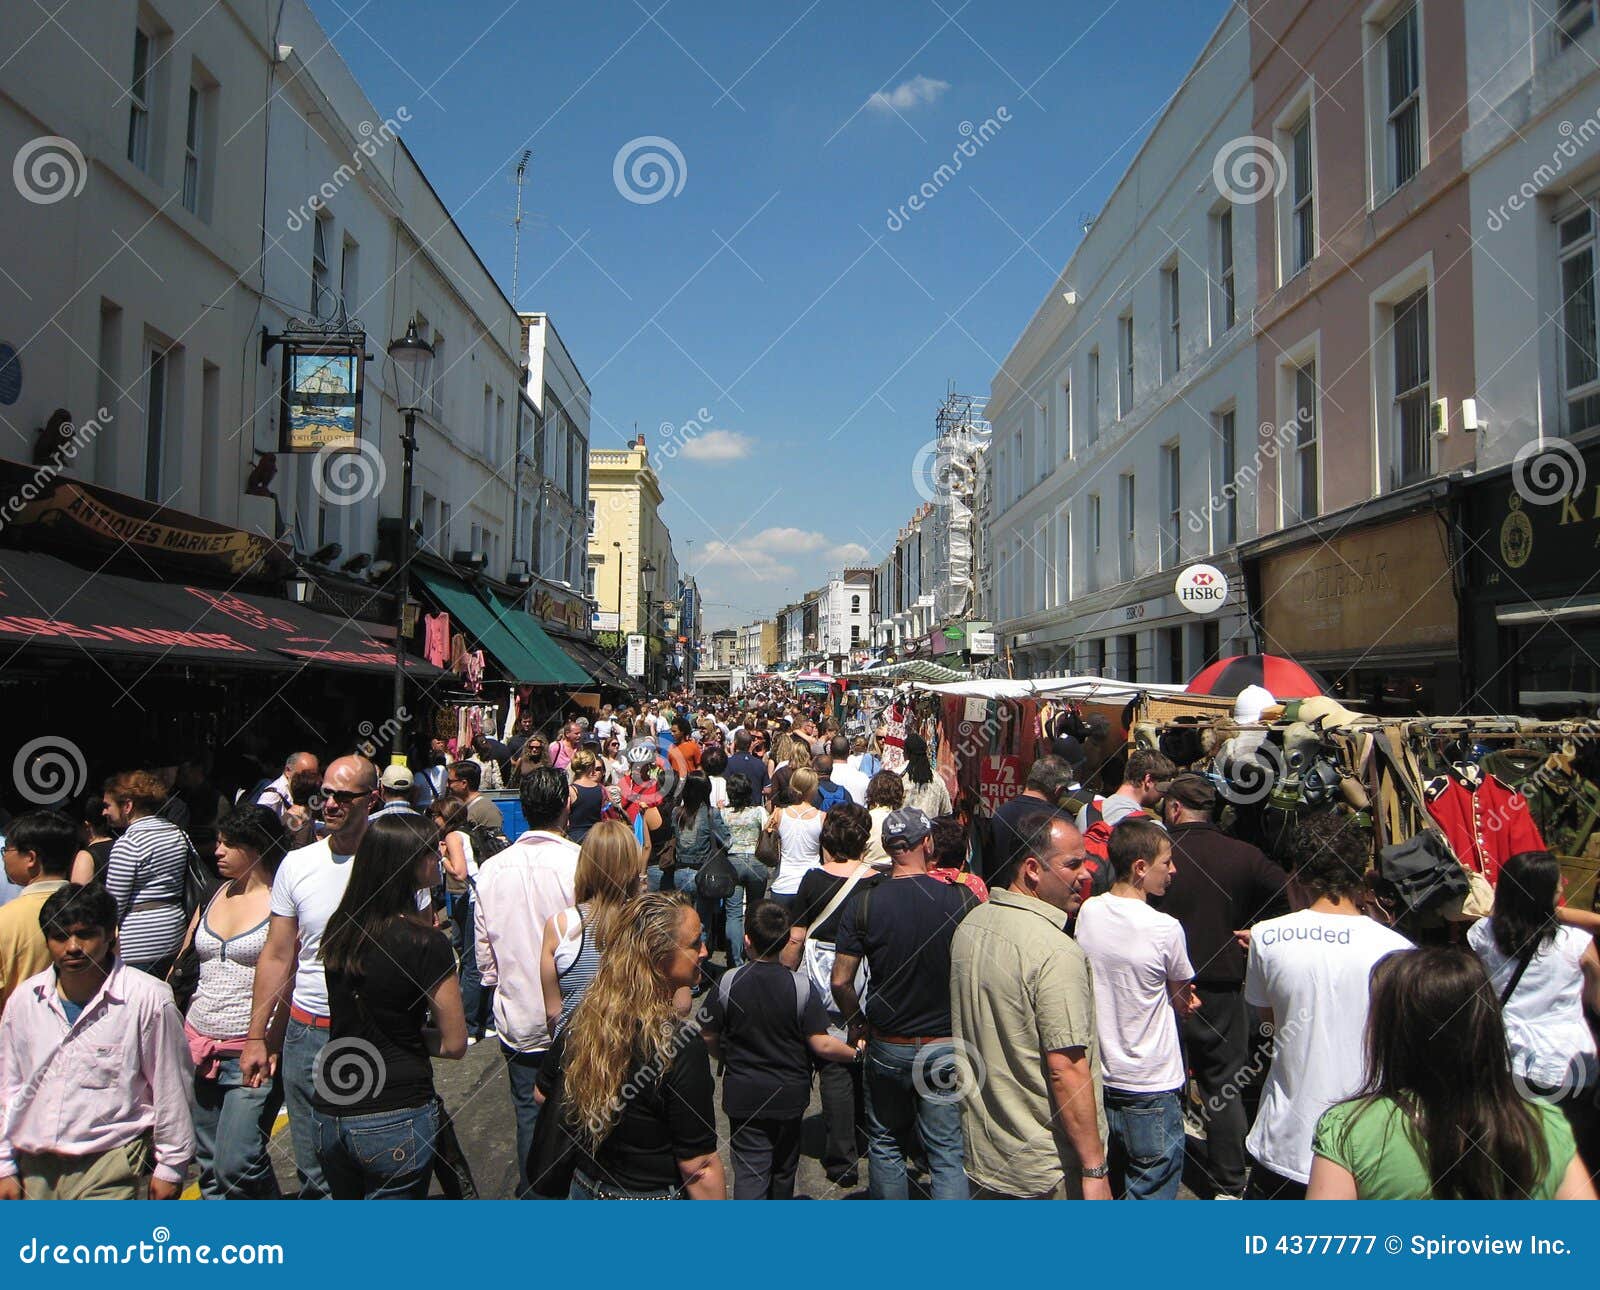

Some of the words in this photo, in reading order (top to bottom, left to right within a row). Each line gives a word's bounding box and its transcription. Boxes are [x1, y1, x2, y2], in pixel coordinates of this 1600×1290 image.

[68, 496, 161, 544] ANTIQUES
[163, 530, 233, 551] MARKET
[1183, 587, 1224, 600] HSBC
[980, 783, 1023, 797] PRICE
[1261, 925, 1351, 946] Clouded
